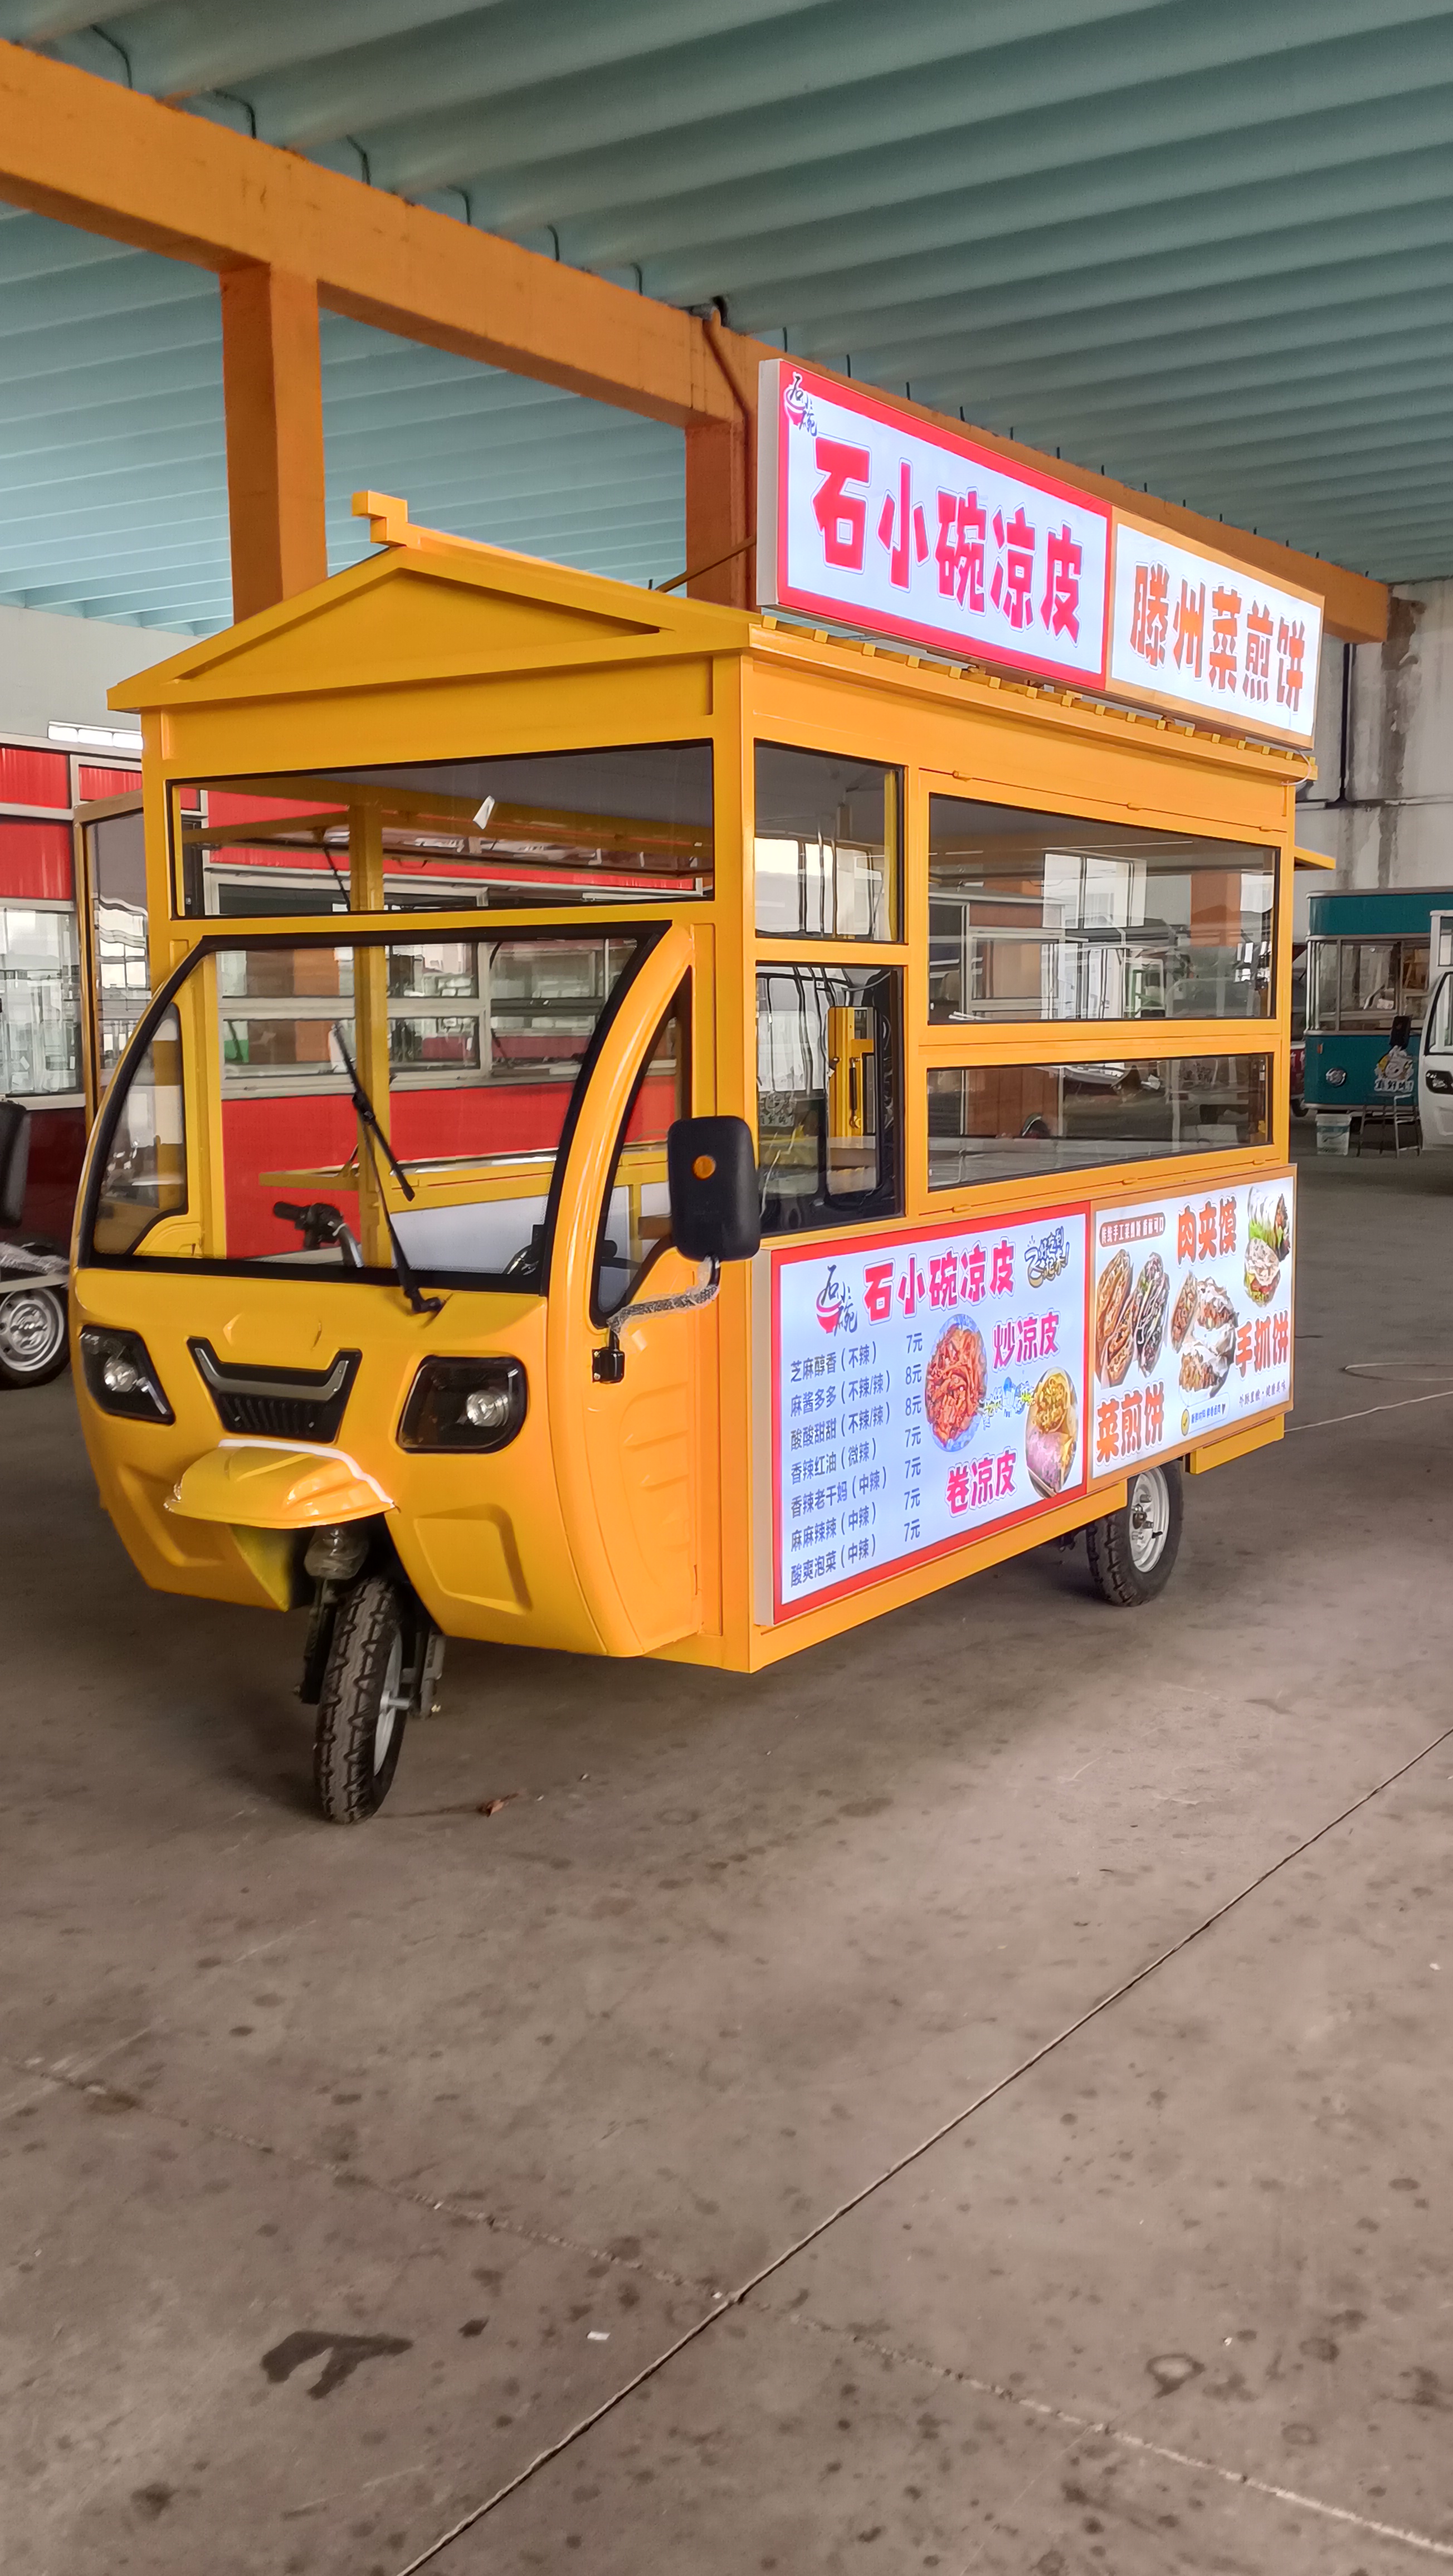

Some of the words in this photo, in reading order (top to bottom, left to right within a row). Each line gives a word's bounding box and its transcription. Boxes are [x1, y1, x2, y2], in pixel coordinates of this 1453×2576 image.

[813, 437, 1083, 638] 石小碗凉皮
[1129, 564, 1305, 712] 滕州菜煎饼
[1177, 1197, 1237, 1265] 肉夹馍
[864, 1240, 1015, 1323] 石小碗凉皮
[906, 1333, 923, 1354] 7元
[993, 1312, 1060, 1369] 炒凉皮
[1236, 1311, 1289, 1378] 手抓饼
[905, 1364, 922, 1384] 8元
[905, 1395, 921, 1416] 8元
[1097, 1382, 1164, 1463] 菜煎饼
[905, 1426, 921, 1447] 7元
[905, 1457, 921, 1479] 7元
[947, 1450, 1017, 1512] 卷凉皮
[904, 1487, 920, 1510] 7元
[904, 1519, 920, 1541] 7元
